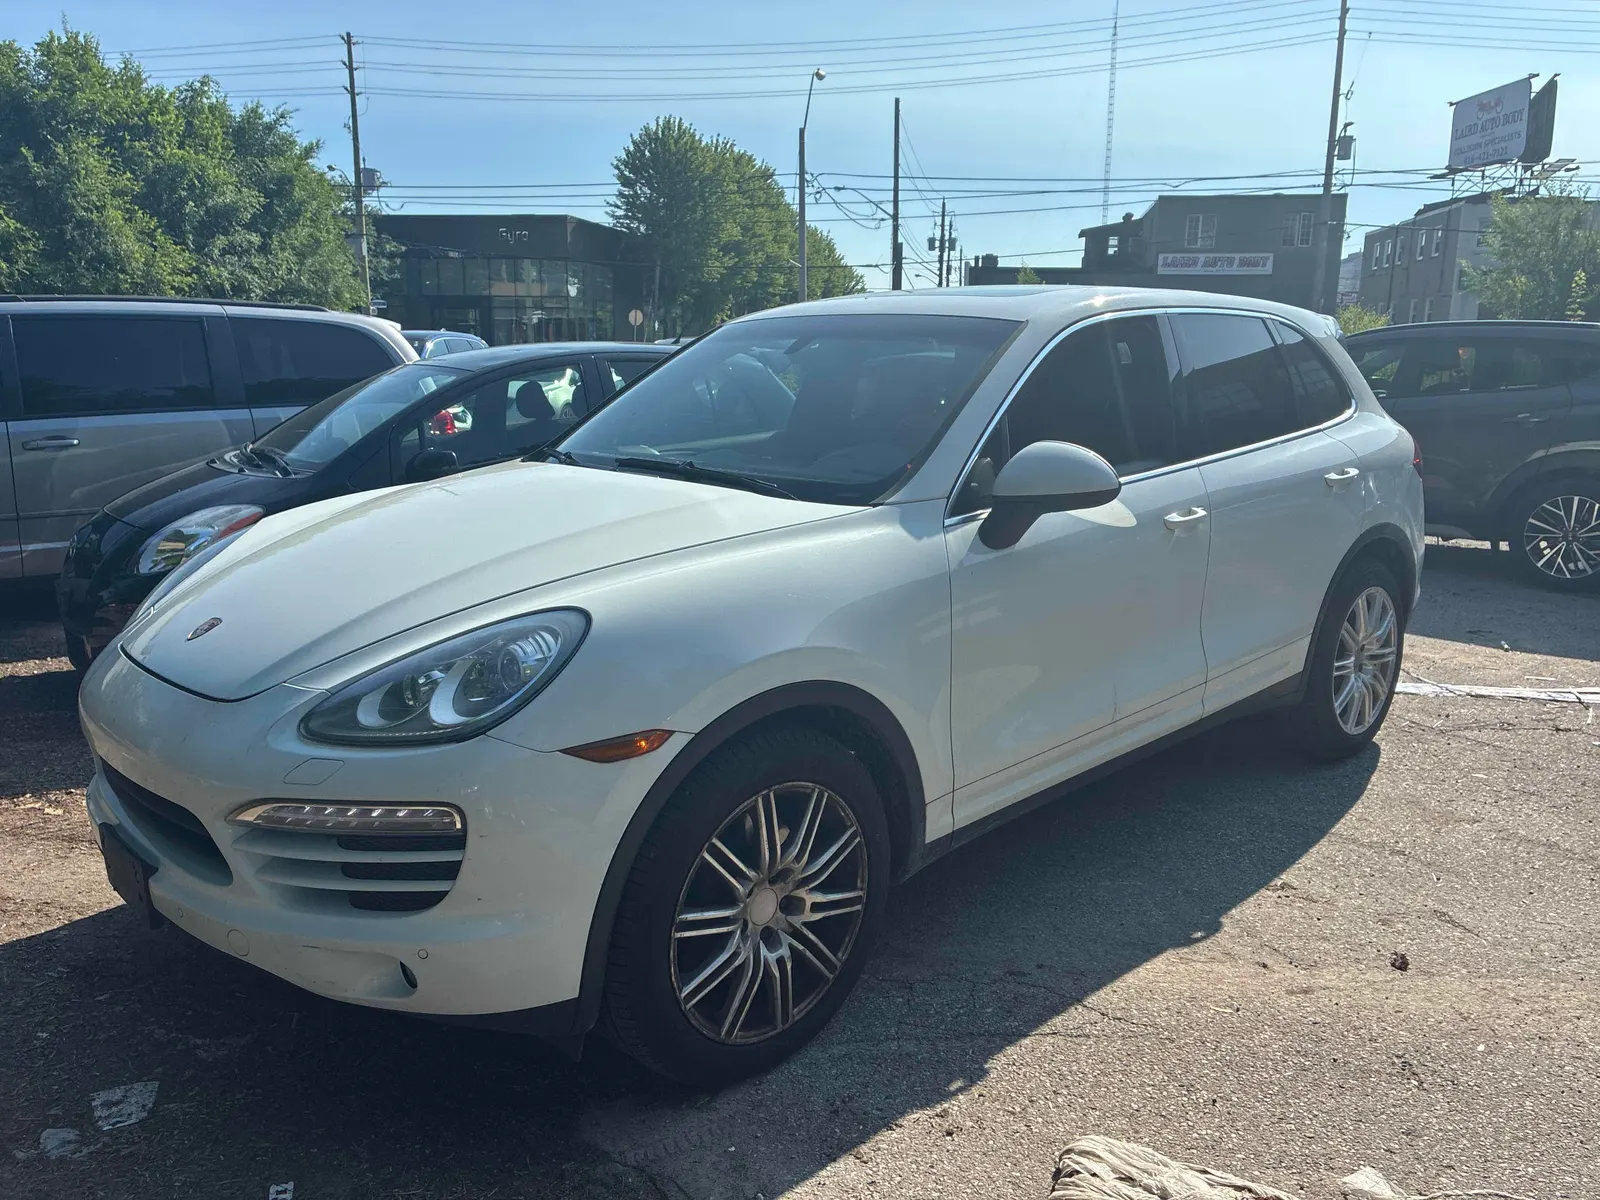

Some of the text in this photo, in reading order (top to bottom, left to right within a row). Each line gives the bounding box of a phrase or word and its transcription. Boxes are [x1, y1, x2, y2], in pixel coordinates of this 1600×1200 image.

[1454, 108, 1525, 141] LAIRD AUTO BODY
[1453, 142, 1483, 157] COLLISION
[499, 228, 529, 243] Gyro
[1161, 256, 1270, 268] LAIRD AUTO BODY
